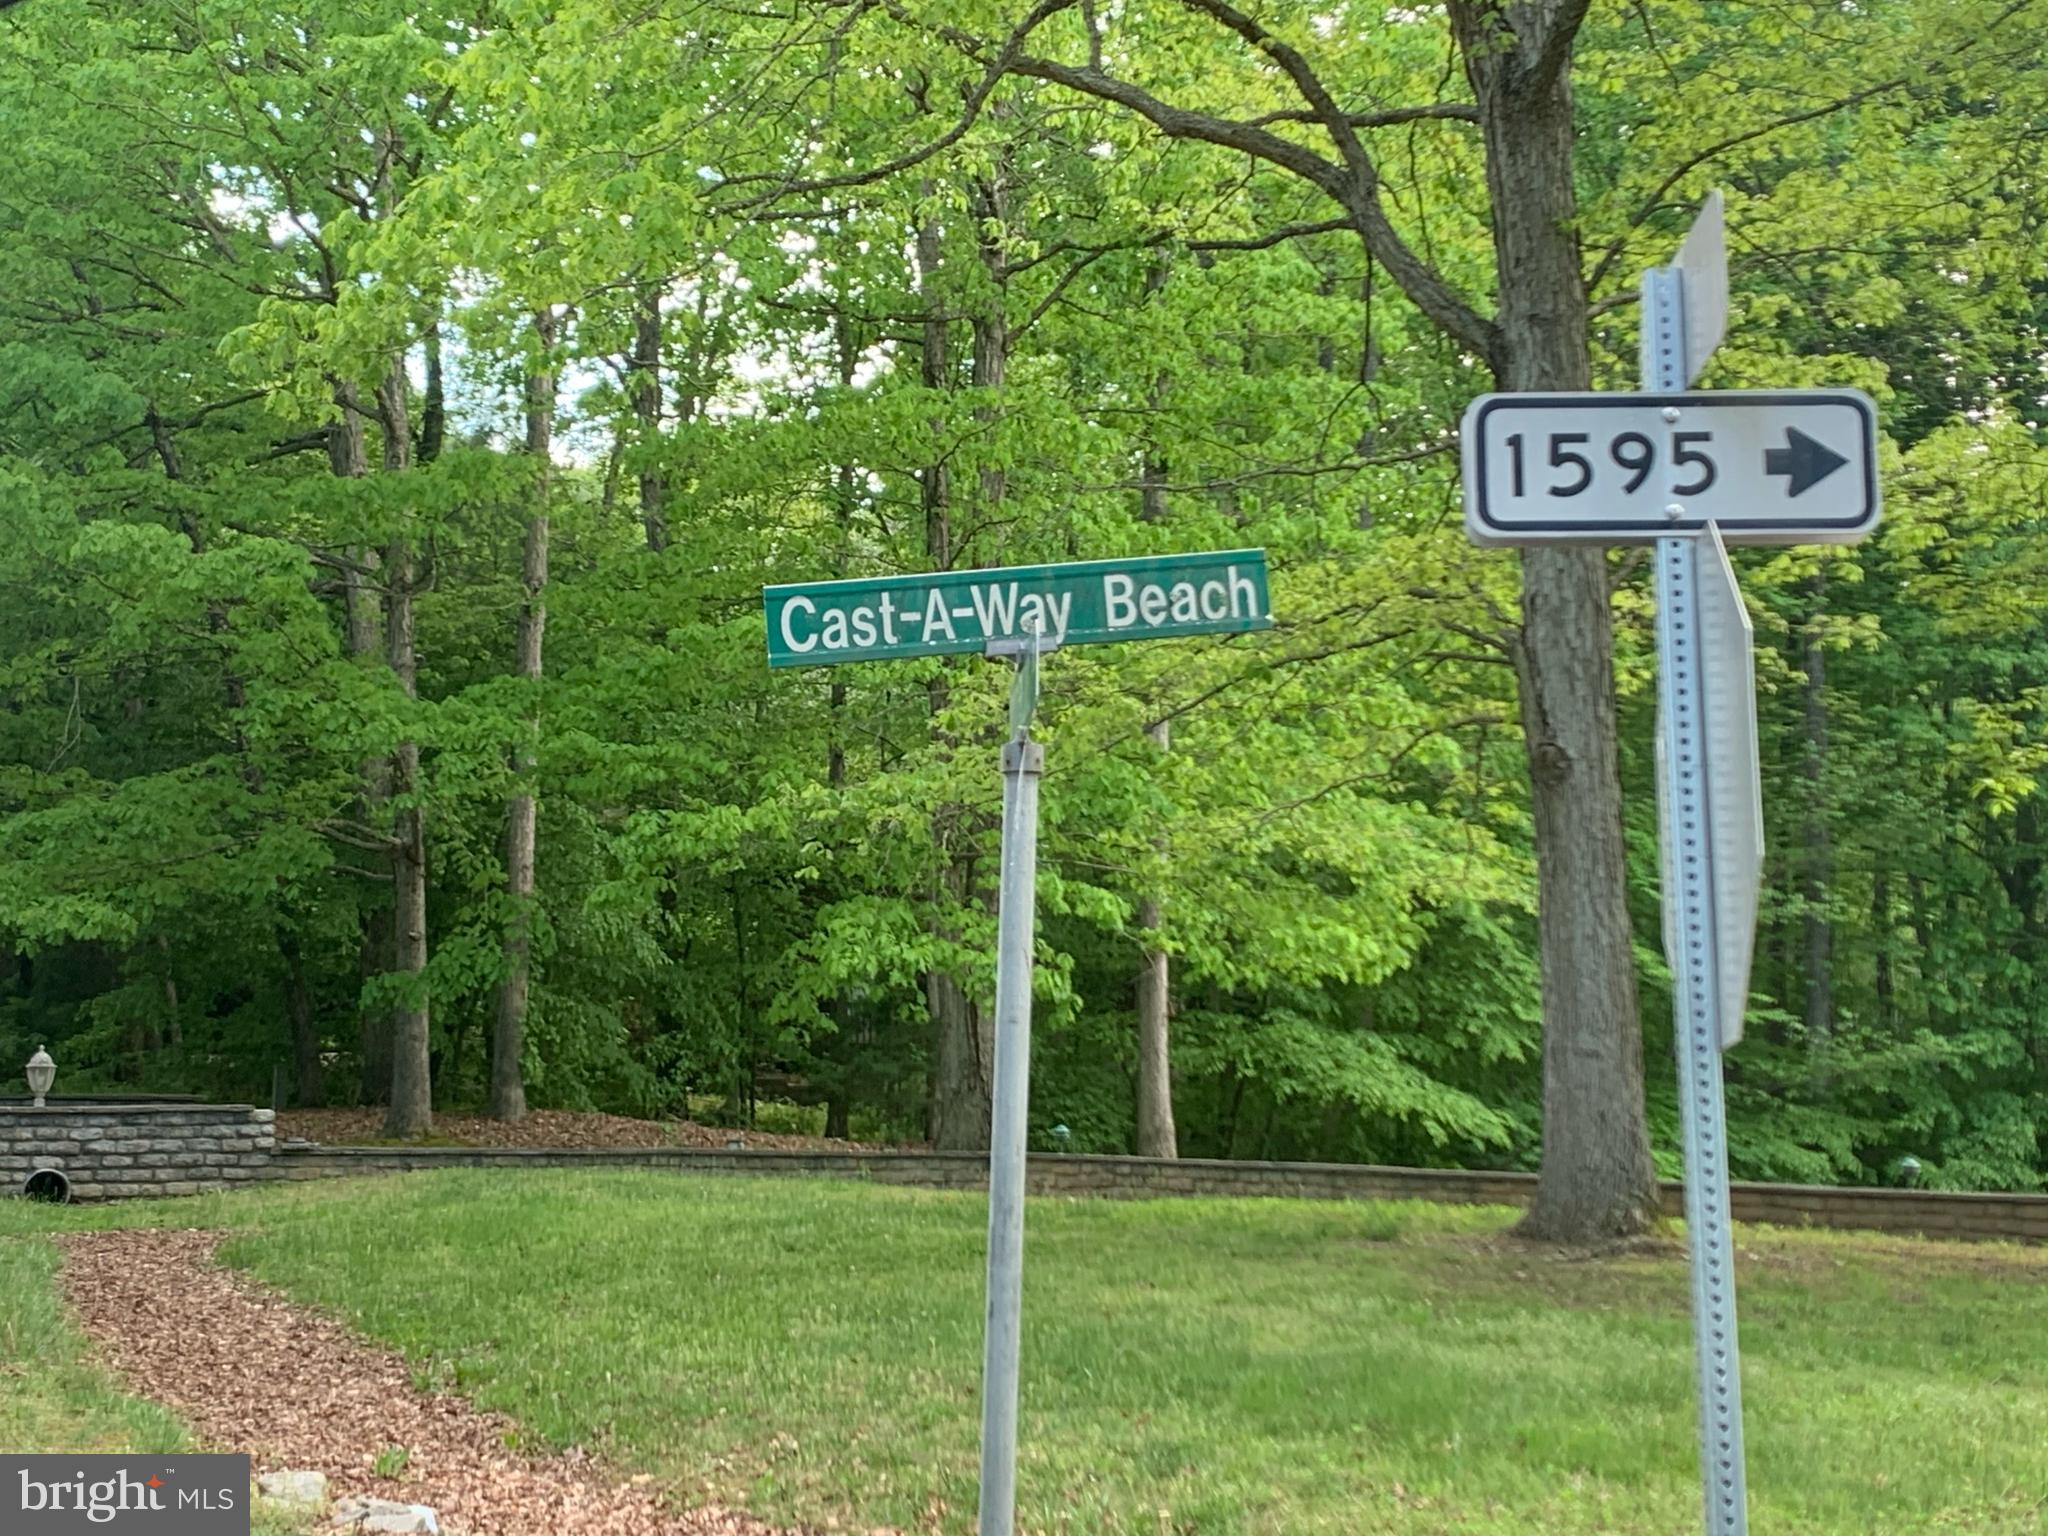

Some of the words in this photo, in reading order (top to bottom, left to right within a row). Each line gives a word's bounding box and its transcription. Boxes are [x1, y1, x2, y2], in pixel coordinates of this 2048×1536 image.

[1506, 431, 1717, 497] 1595
[781, 582, 1071, 653] Cast-A-Way
[1104, 566, 1258, 627] Beach
